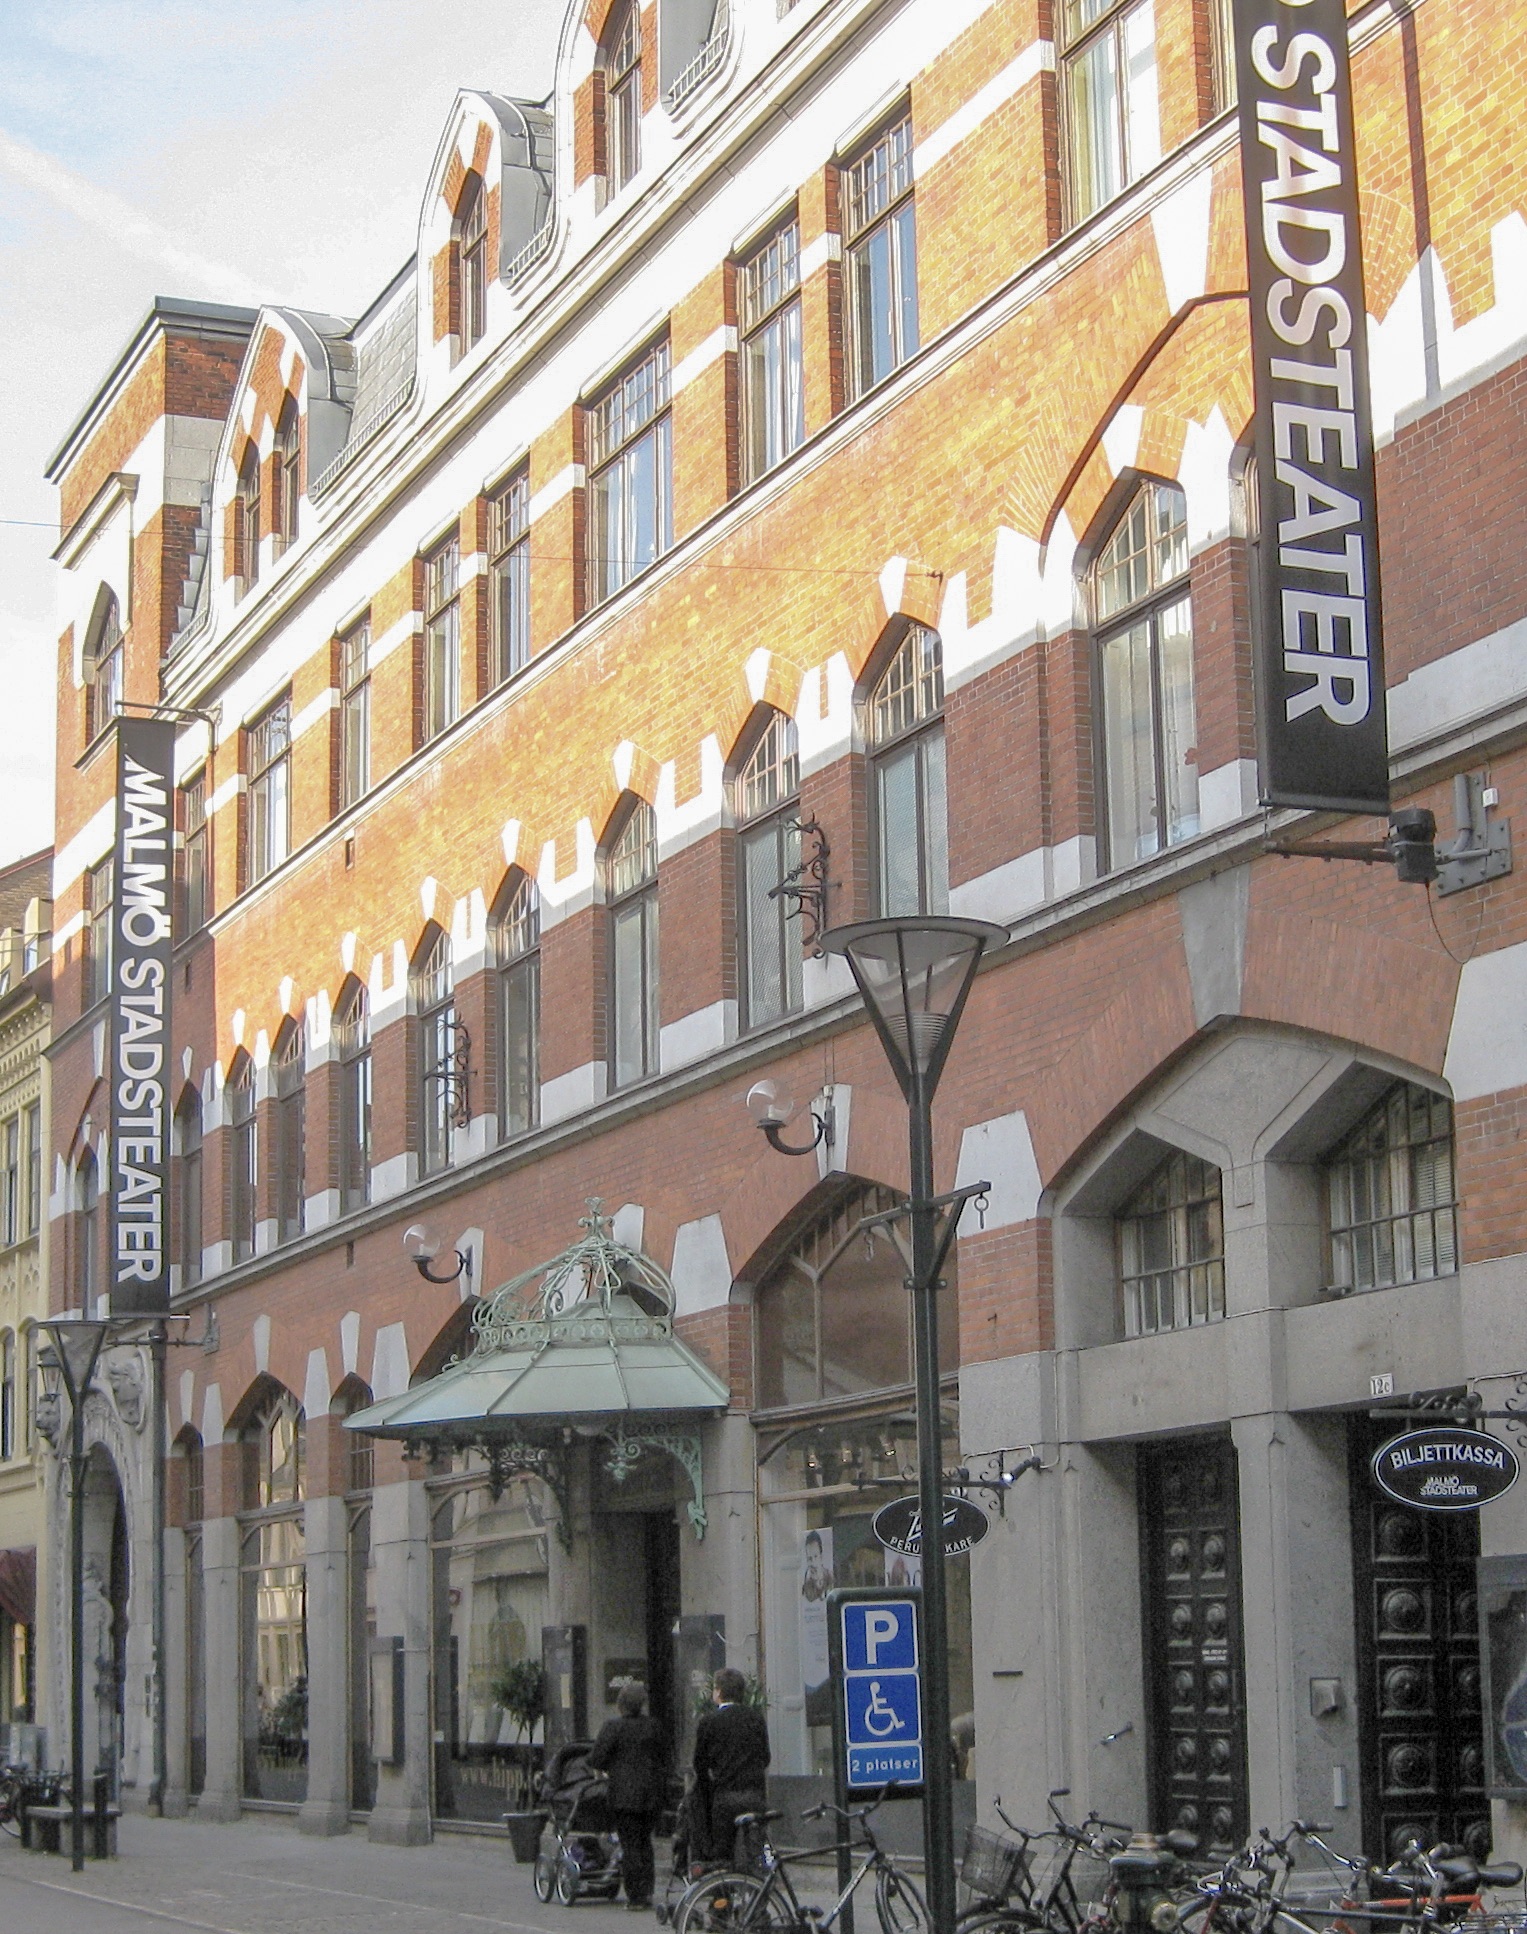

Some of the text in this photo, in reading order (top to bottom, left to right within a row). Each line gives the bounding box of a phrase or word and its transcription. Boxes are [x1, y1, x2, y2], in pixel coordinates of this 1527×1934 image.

[1250, 24, 1371, 727] STADSTEATER
[116, 753, 170, 1283] MALMÖ STADSTEATER
[1390, 1443, 1504, 1469] BILJETTKASSA
[865, 1610, 899, 1665] P
[852, 1758, 918, 1774] 2 platser
